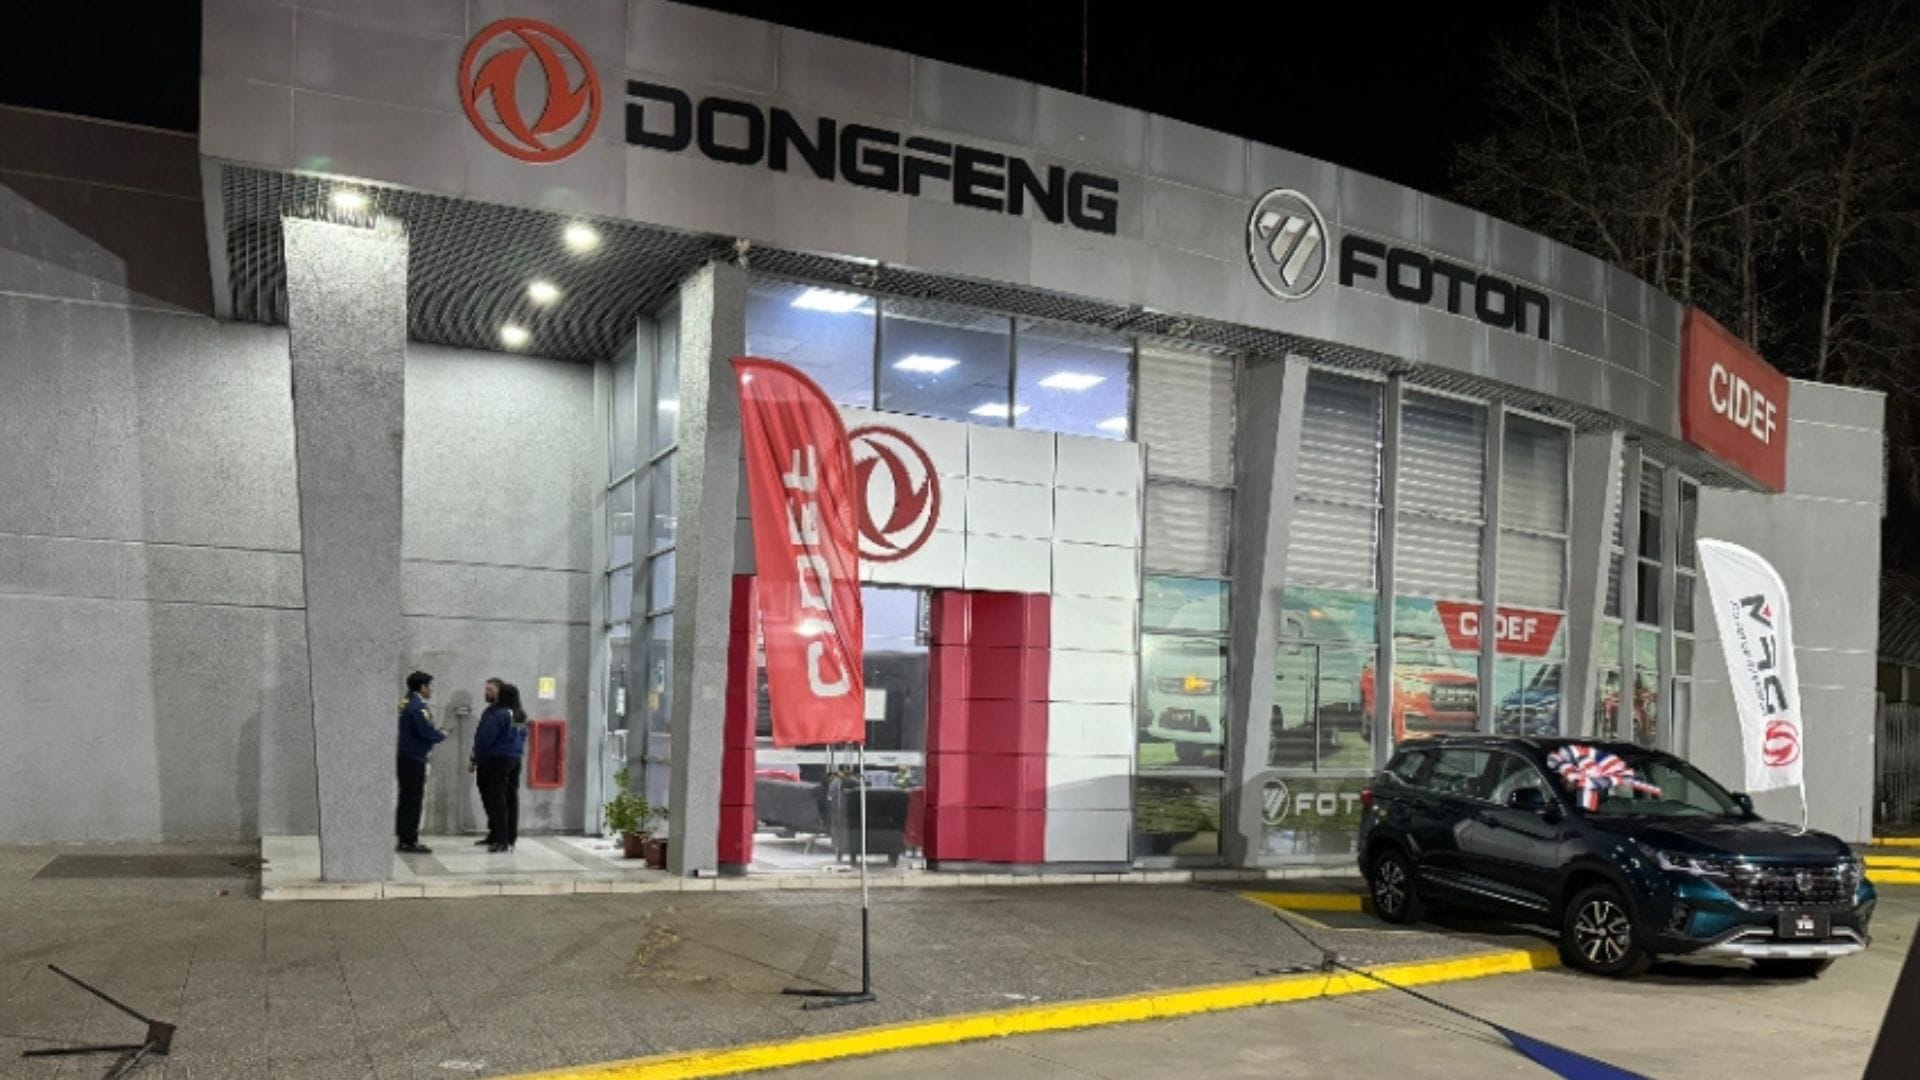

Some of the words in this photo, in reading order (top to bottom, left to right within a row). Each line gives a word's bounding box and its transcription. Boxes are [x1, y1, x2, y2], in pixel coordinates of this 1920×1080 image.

[626, 79, 1119, 234] DONGFENG
[1339, 234, 1550, 341] FOTON
[1709, 362, 1776, 445] CIDEF
[1459, 612, 1537, 642] CDEF
[1296, 792, 1361, 816] FOT
